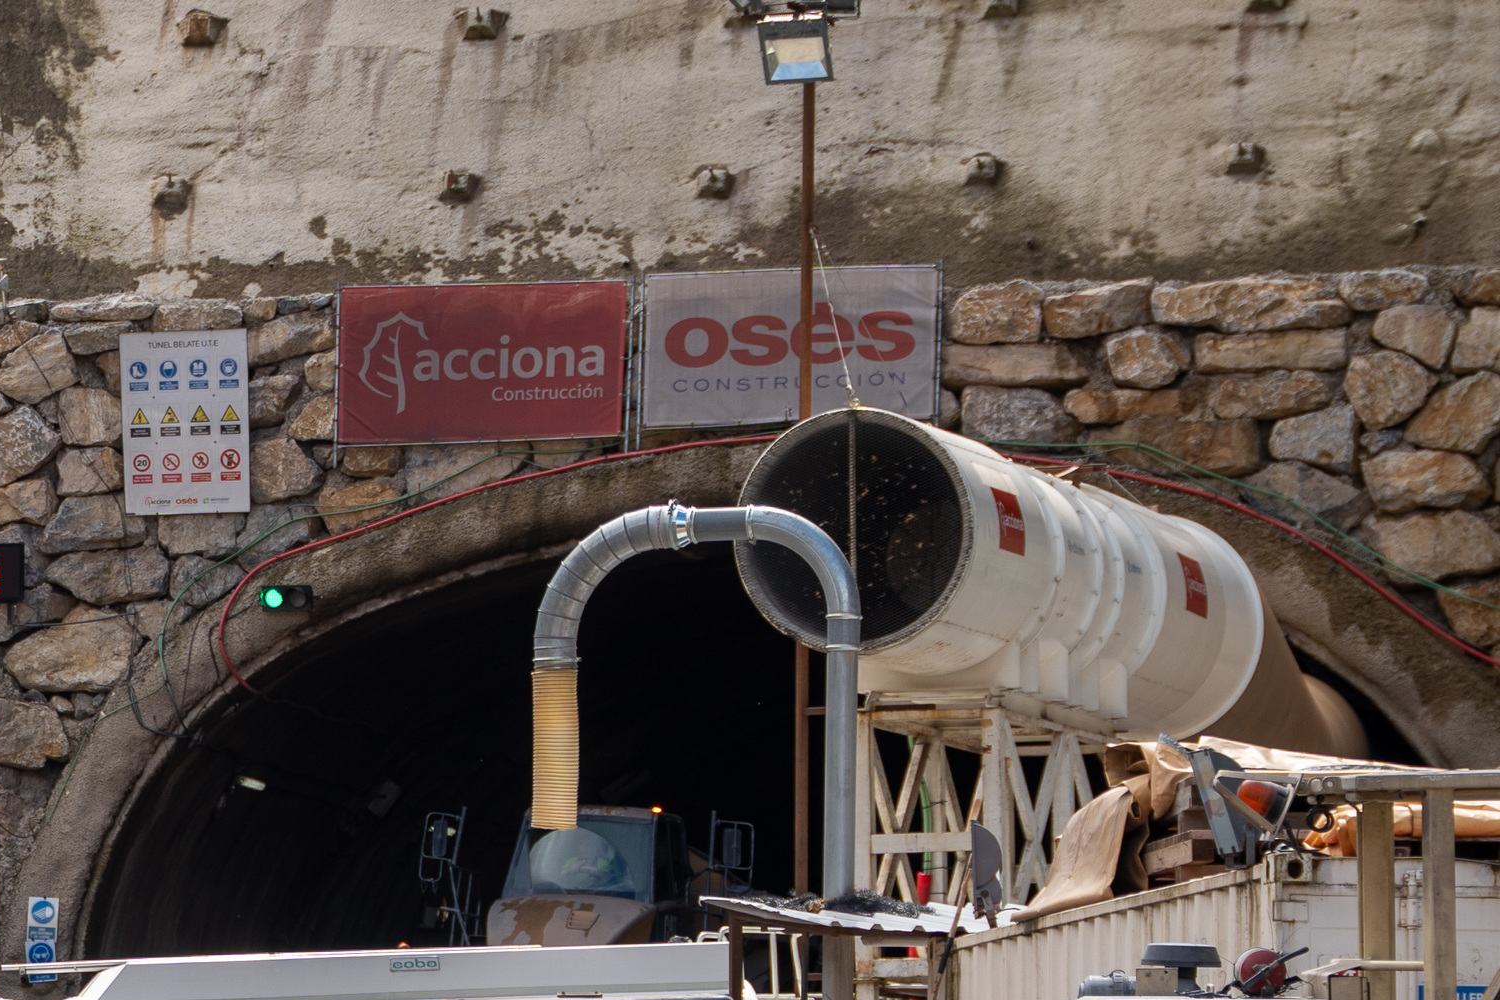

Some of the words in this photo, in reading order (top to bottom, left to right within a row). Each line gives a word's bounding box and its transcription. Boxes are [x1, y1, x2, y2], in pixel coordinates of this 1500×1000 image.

[148, 341, 172, 349] TÚNEL
[173, 340, 200, 348] BELATE
[413, 335, 605, 381] acciona
[672, 370, 906, 393] CONSTRCCIÓN
[491, 383, 604, 402] Construcción
